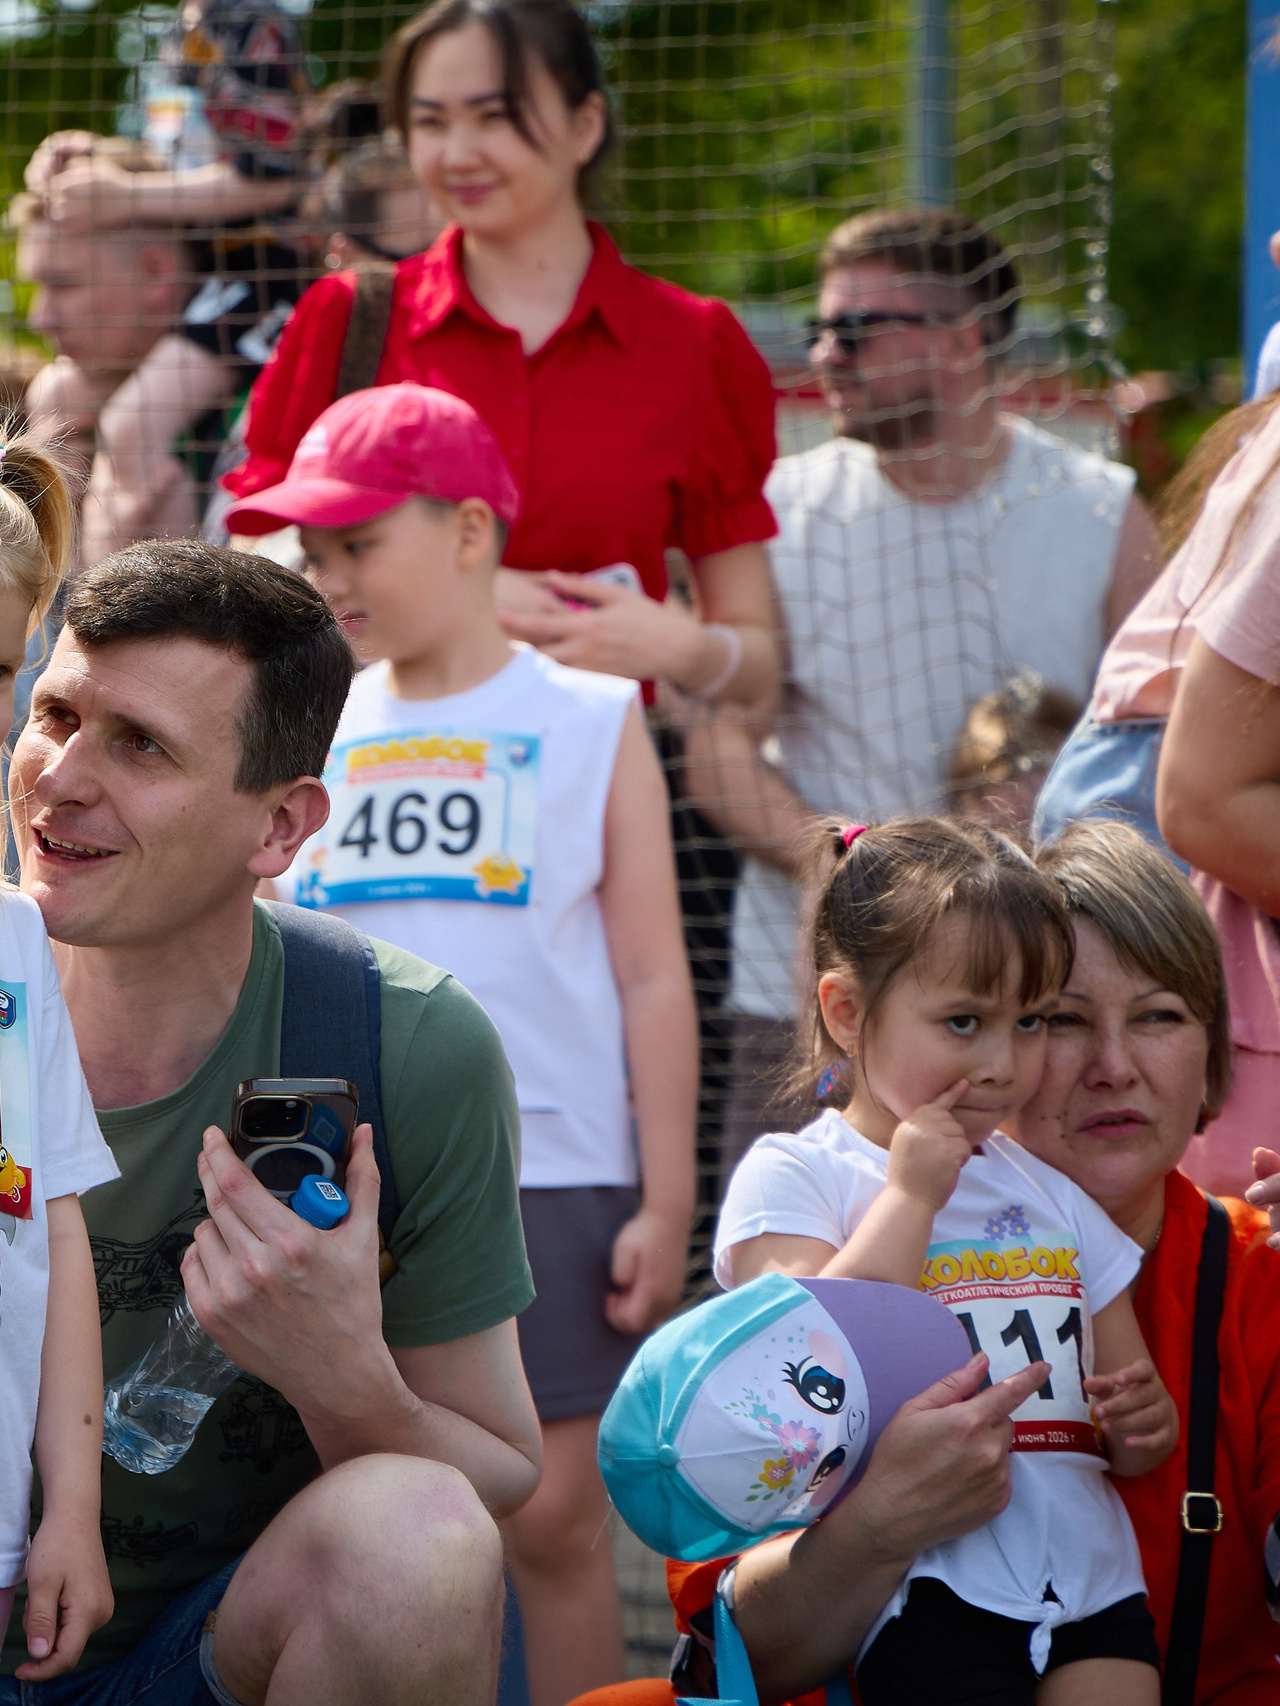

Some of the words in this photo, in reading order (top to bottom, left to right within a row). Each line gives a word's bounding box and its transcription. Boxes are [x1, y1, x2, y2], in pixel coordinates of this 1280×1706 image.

[339, 790, 481, 858] 469
[1039, 1283, 1073, 1295] ПРОБЕГ
[1018, 1434, 1045, 1443] июня
[1047, 1431, 1069, 1443] 2026
